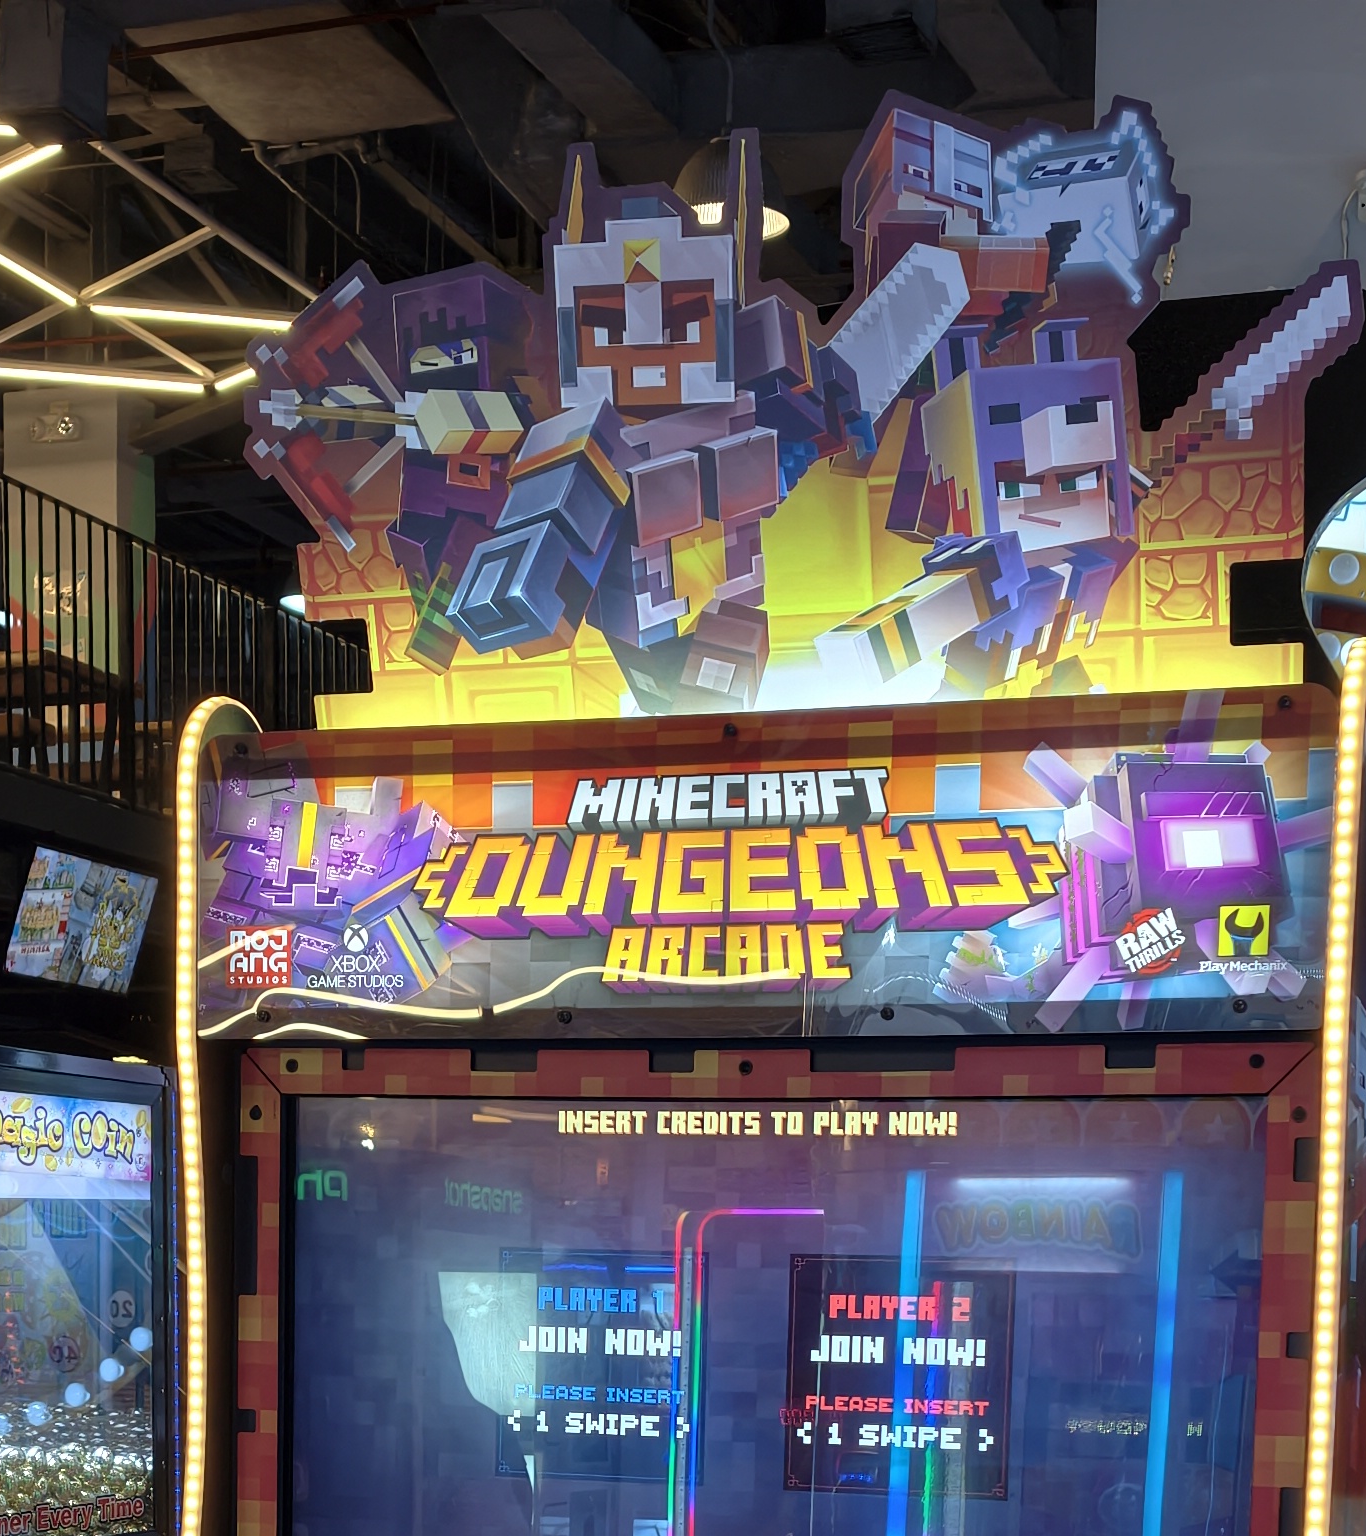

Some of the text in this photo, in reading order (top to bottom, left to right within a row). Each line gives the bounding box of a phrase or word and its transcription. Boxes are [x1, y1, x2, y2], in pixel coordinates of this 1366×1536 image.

[568, 772, 887, 830] MINECRAFT
[441, 820, 1033, 938] DUNGEONS
[1115, 907, 1178, 961] RAW
[331, 955, 380, 973] XBOX
[601, 922, 853, 990] ARCADE
[1125, 930, 1186, 973] THRILLS
[229, 976, 288, 985] STUDIOS
[307, 975, 404, 988] GAME STUDIOS
[558, 1110, 959, 1137] INSERT CREDITS TO PLAY NOW!
[537, 1286, 665, 1313] PLAYER 1
[829, 1293, 971, 1322] PLAYER 2
[519, 1326, 682, 1357] JOIN NOW!
[809, 1335, 987, 1367] JOIN NOW!
[513, 1384, 685, 1405] PLEASE INSERT
[805, 1395, 990, 1417] PLEASE INSERT
[535, 1411, 661, 1437] 1 SWIPE
[827, 1423, 961, 1449] 1 SWIPE
[36, 1501, 94, 1532] Every
[95, 1496, 144, 1521] Time
